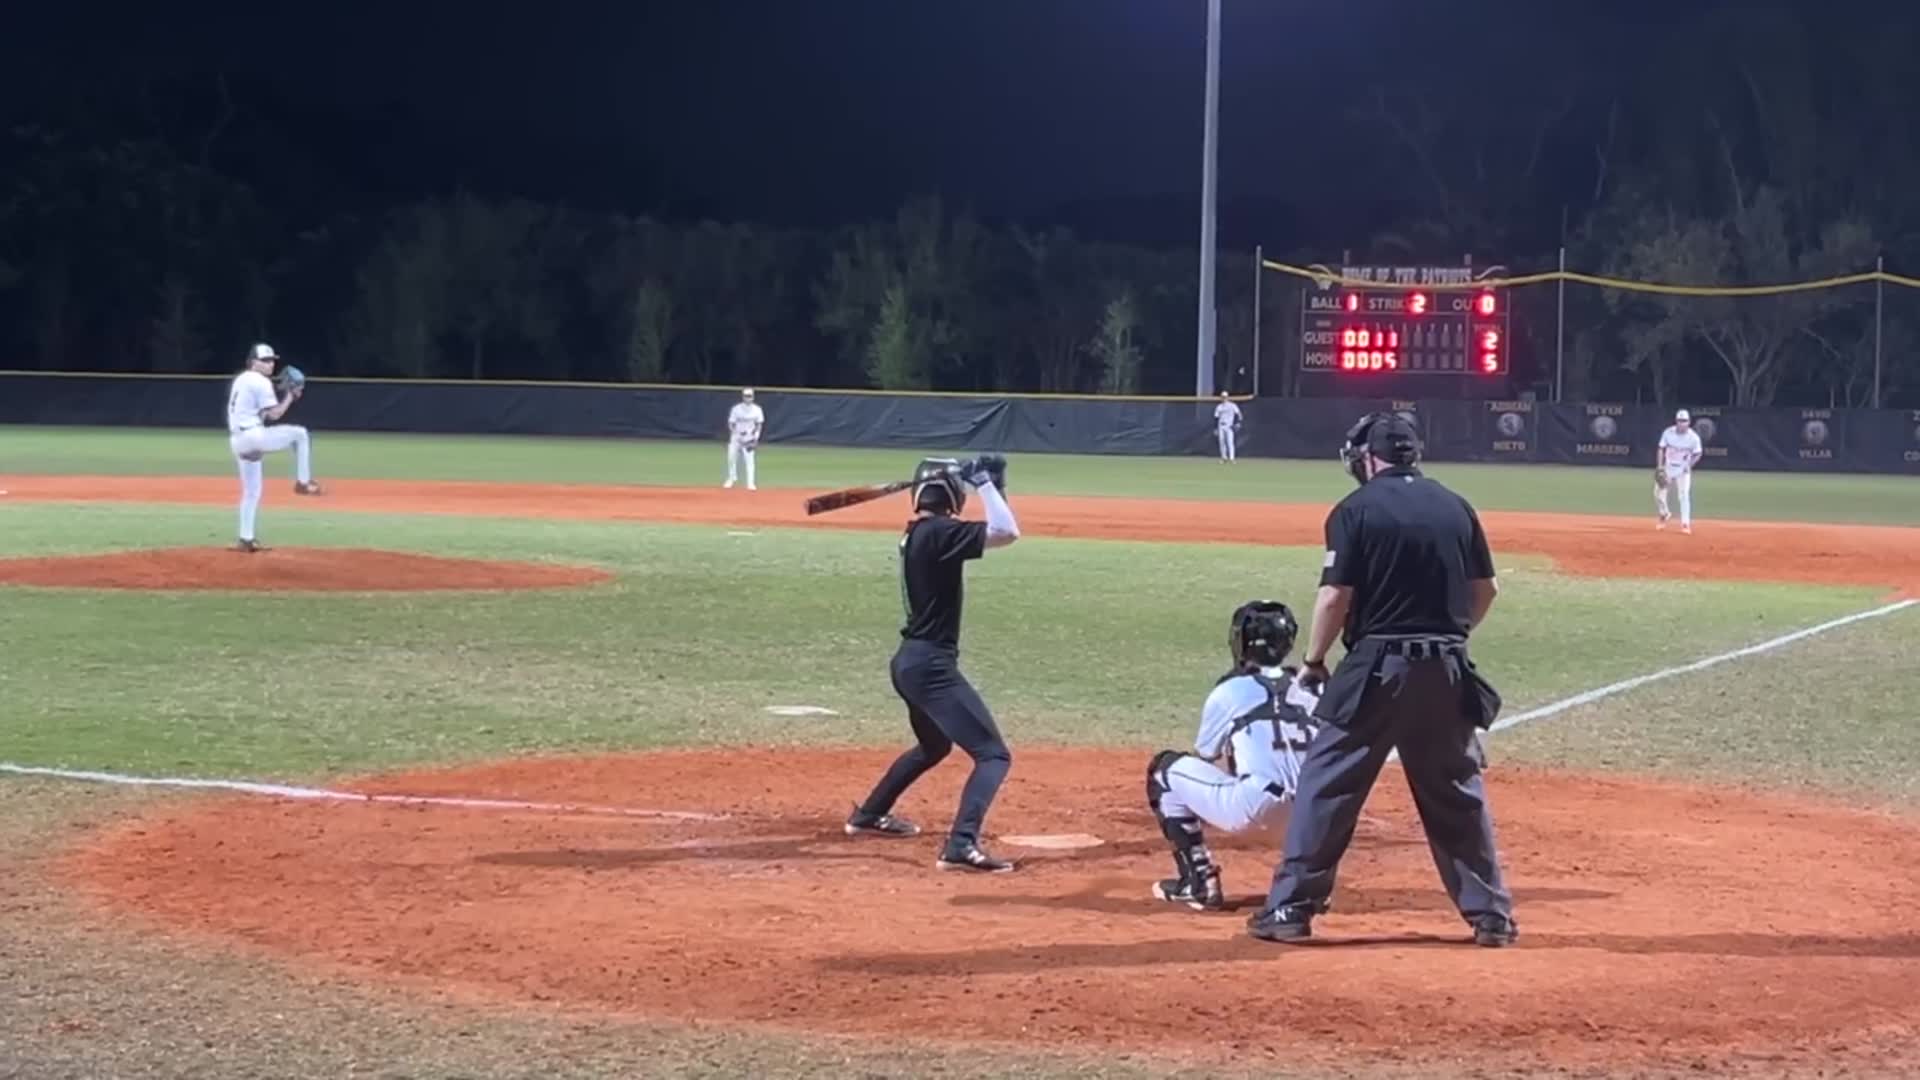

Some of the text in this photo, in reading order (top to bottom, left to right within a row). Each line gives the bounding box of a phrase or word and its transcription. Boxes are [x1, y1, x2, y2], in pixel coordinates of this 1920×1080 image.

[1311, 296, 1343, 309] BALL
[1347, 294, 1358, 311] 1
[1408, 293, 1427, 314] 2
[1452, 298, 1474, 311] OU
[1480, 294, 1497, 314] 0
[1483, 331, 1499, 350] 2
[1483, 353, 1498, 372] 5
